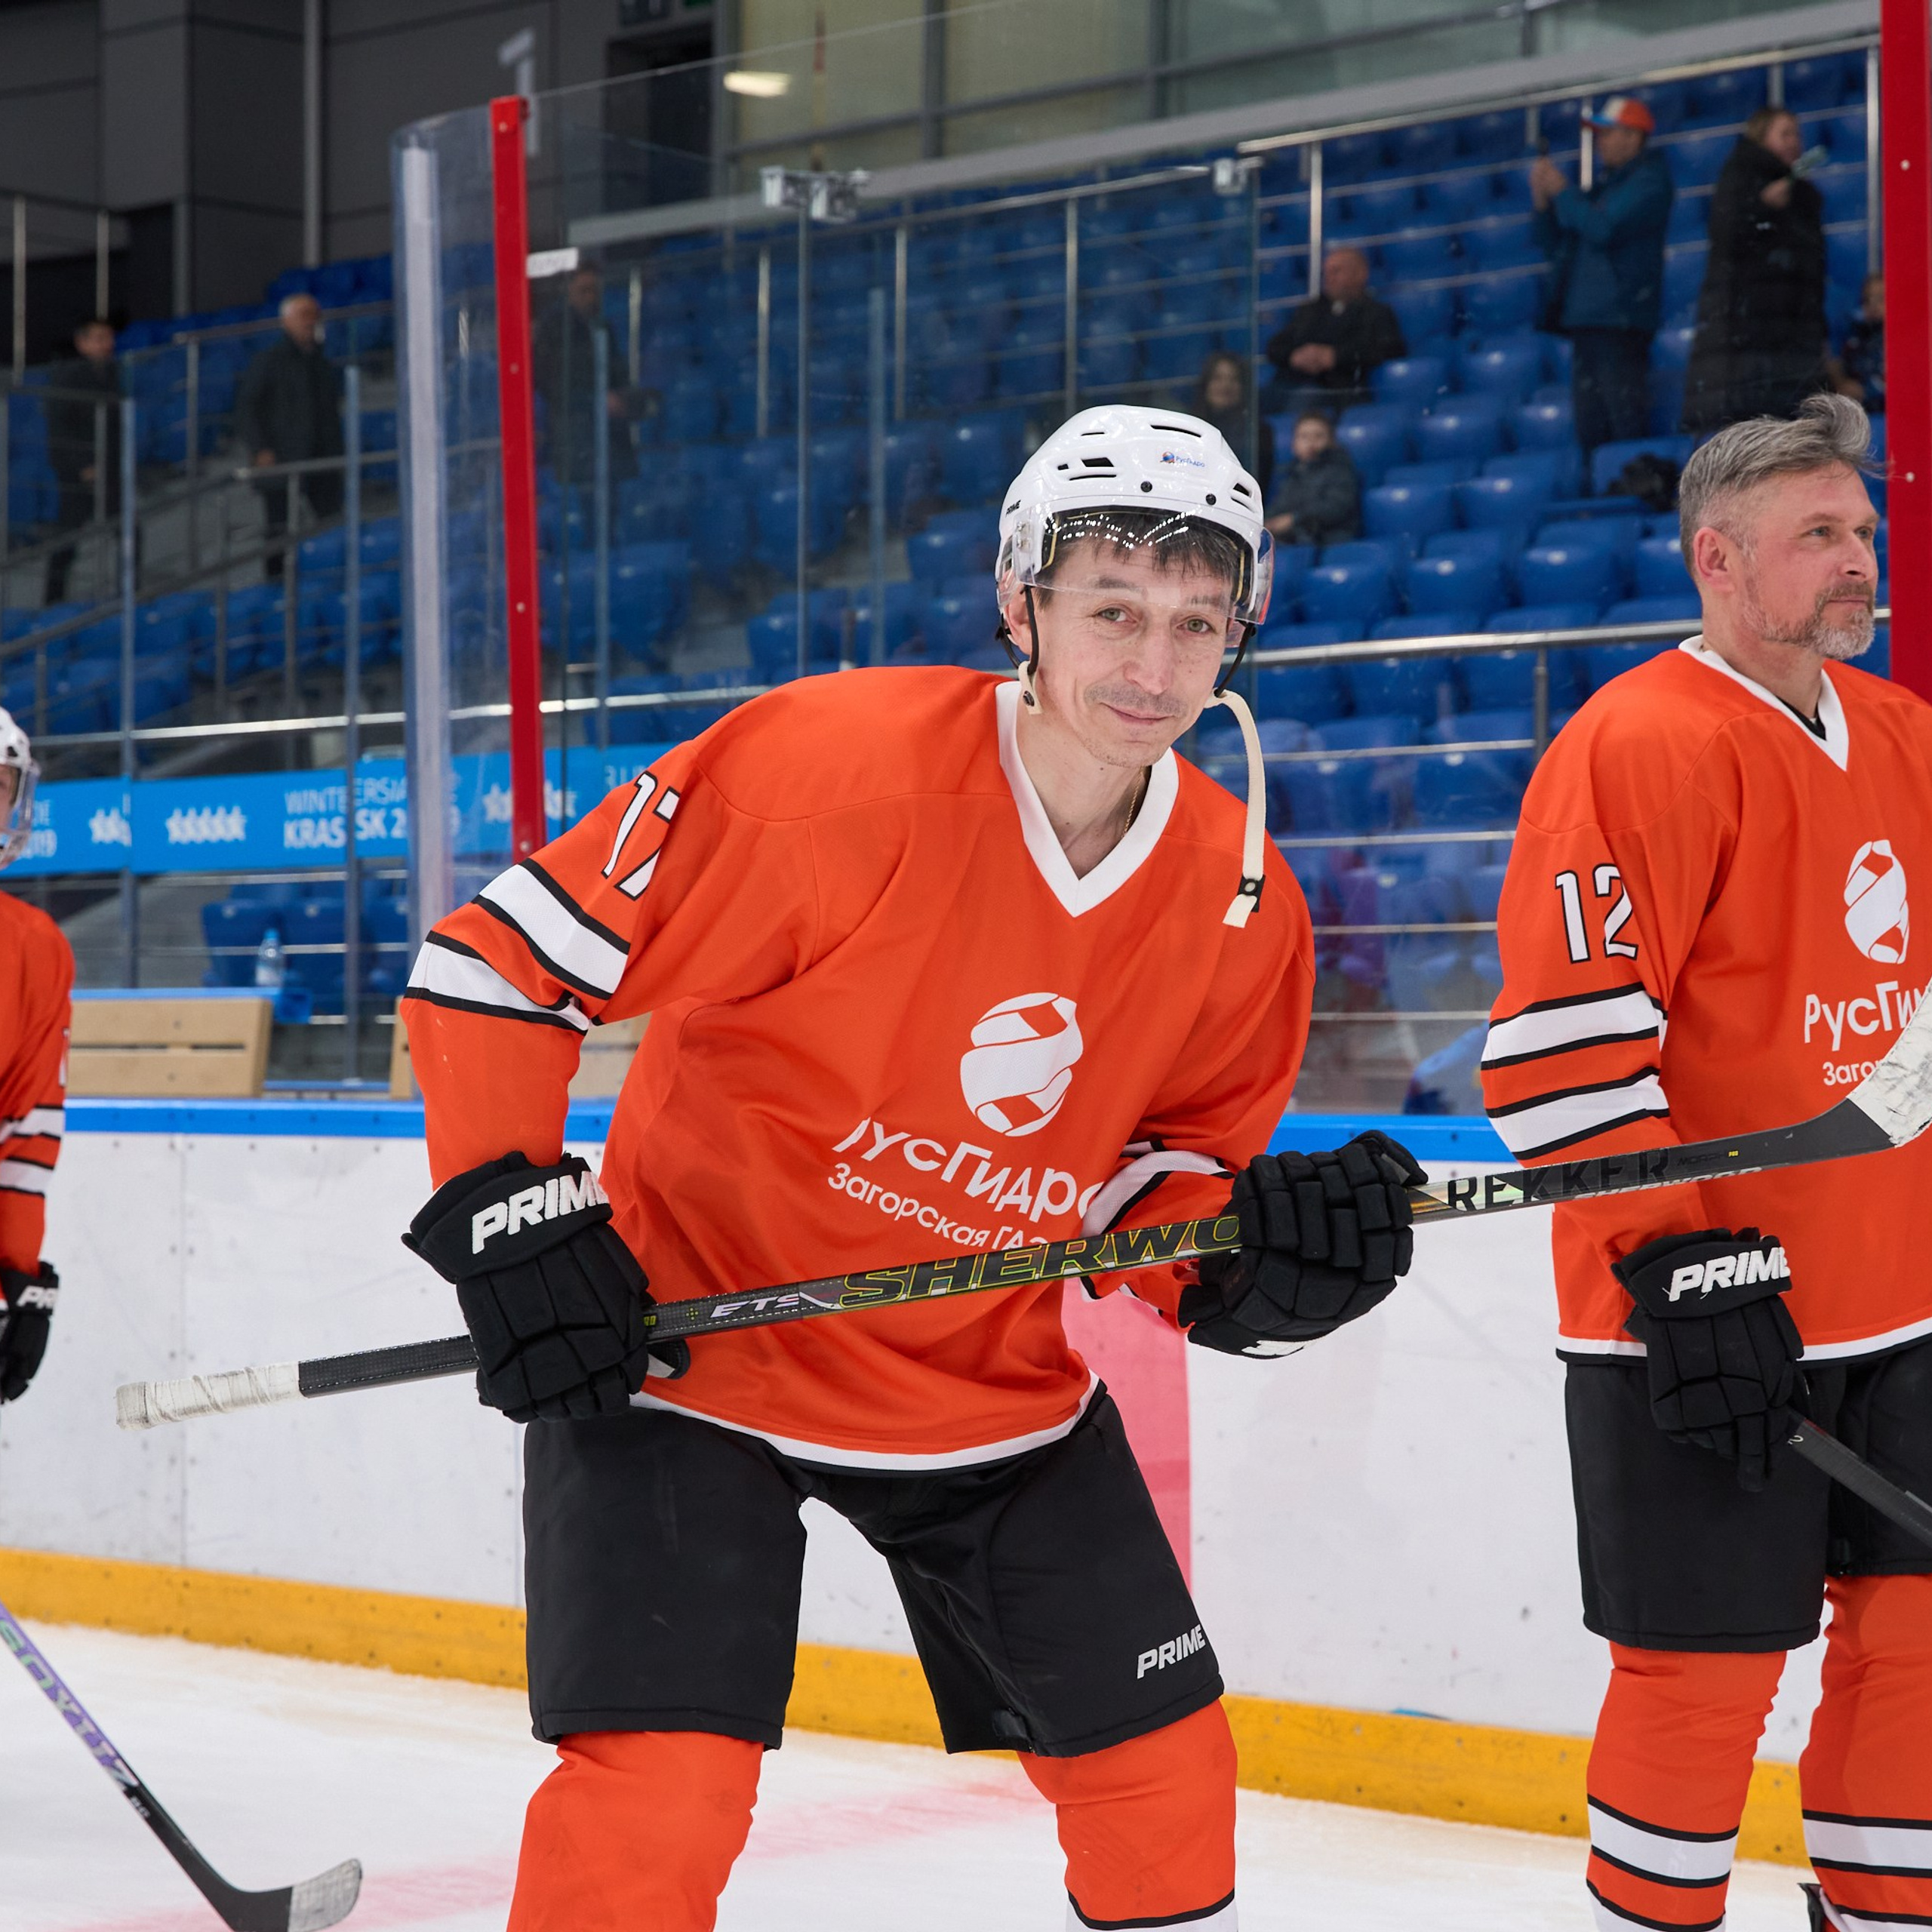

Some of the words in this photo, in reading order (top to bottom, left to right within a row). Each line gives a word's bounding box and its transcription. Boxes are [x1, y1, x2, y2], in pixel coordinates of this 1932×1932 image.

[1555, 863, 1639, 964] 12
[827, 1162, 991, 1247] Загорская
[1137, 1623, 1206, 1679] PRIME
